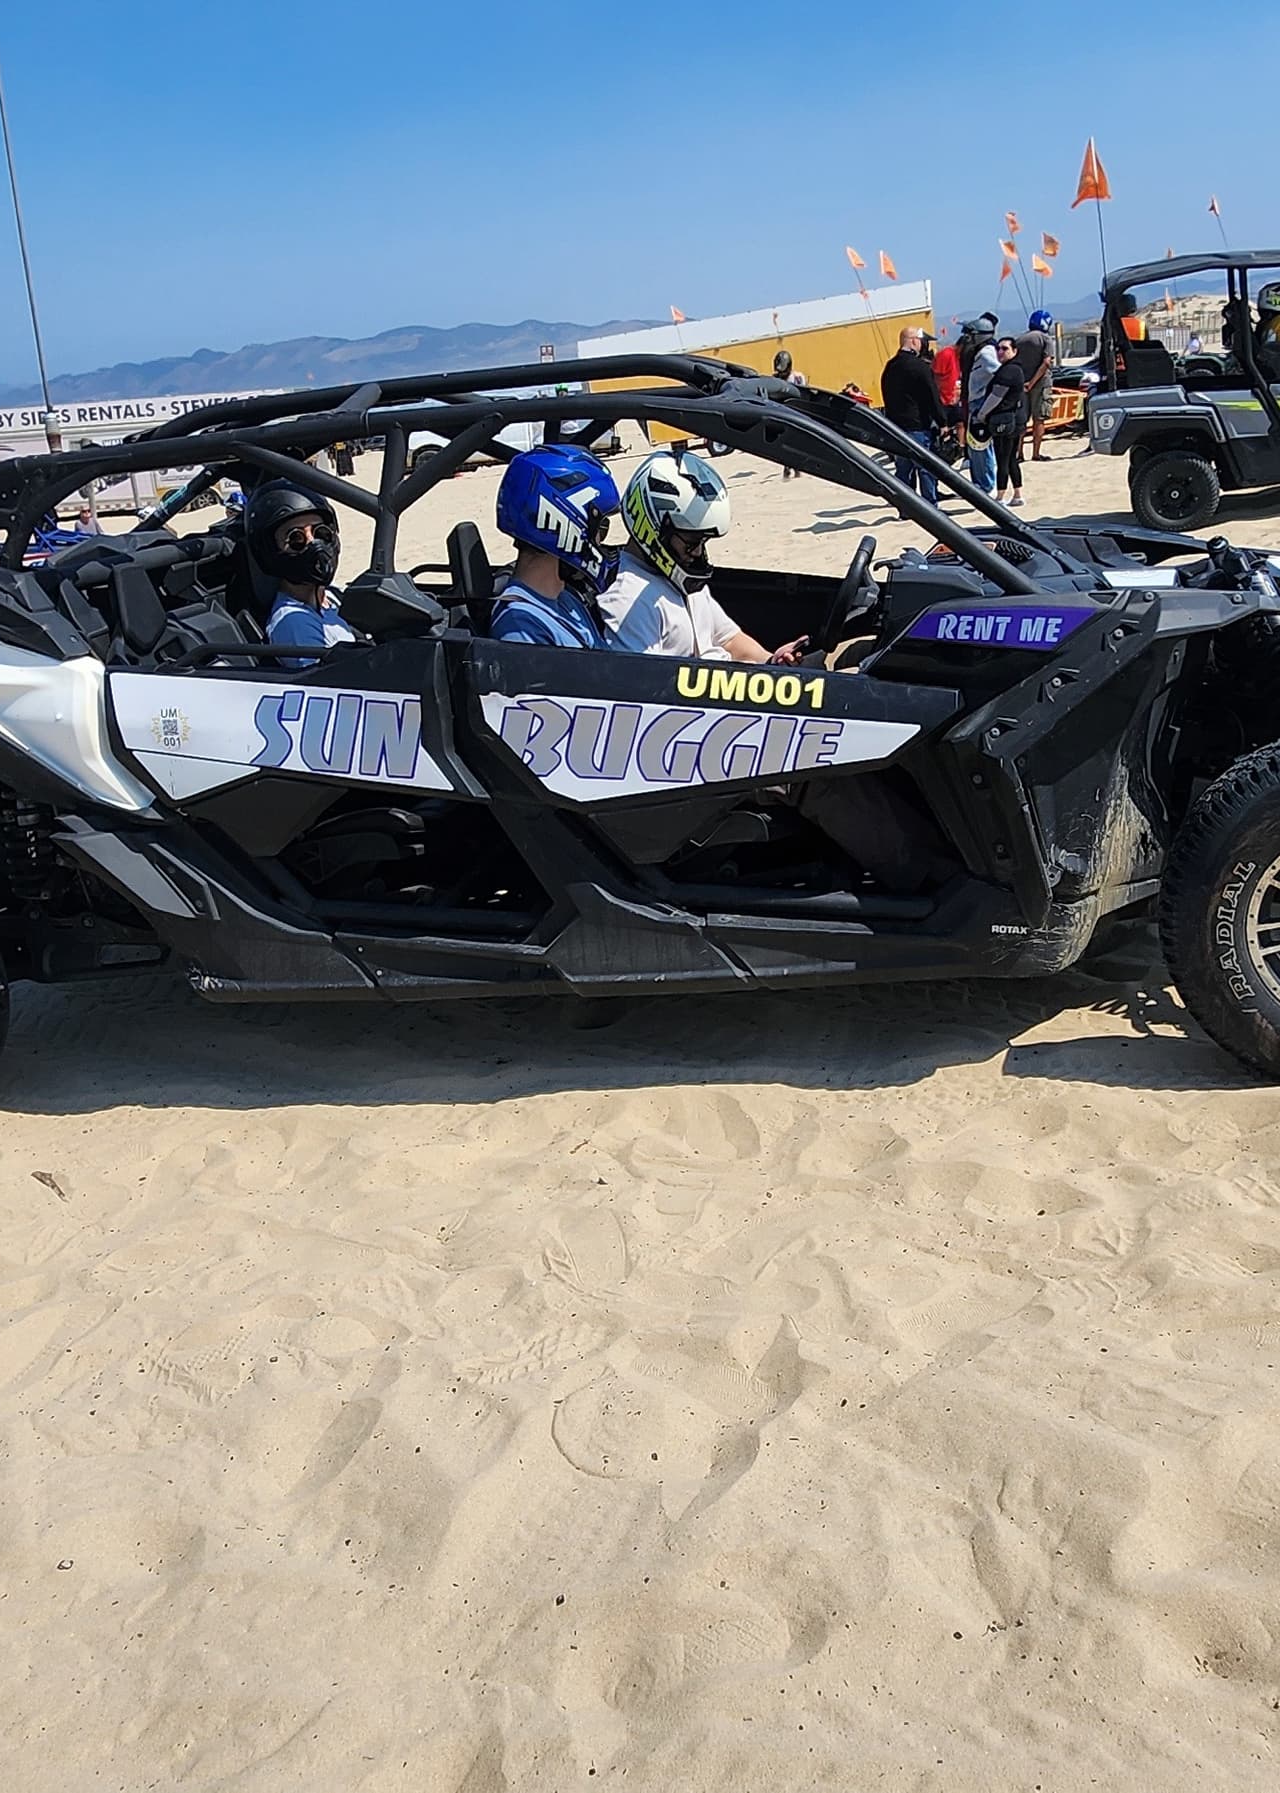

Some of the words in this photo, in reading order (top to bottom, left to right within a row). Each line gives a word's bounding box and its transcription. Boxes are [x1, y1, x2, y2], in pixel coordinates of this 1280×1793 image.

[77, 403, 155, 422] RENTALS
[937, 614, 1012, 641] RENT
[1020, 617, 1063, 643] ME
[676, 666, 825, 709] UM001
[160, 708, 177, 718] UM
[163, 737, 181, 748] 001
[250, 690, 422, 779] SUN
[499, 698, 846, 784] BUGGIE
[991, 925, 1028, 934] ROTAX
[1215, 860, 1257, 1000] RADIAL
